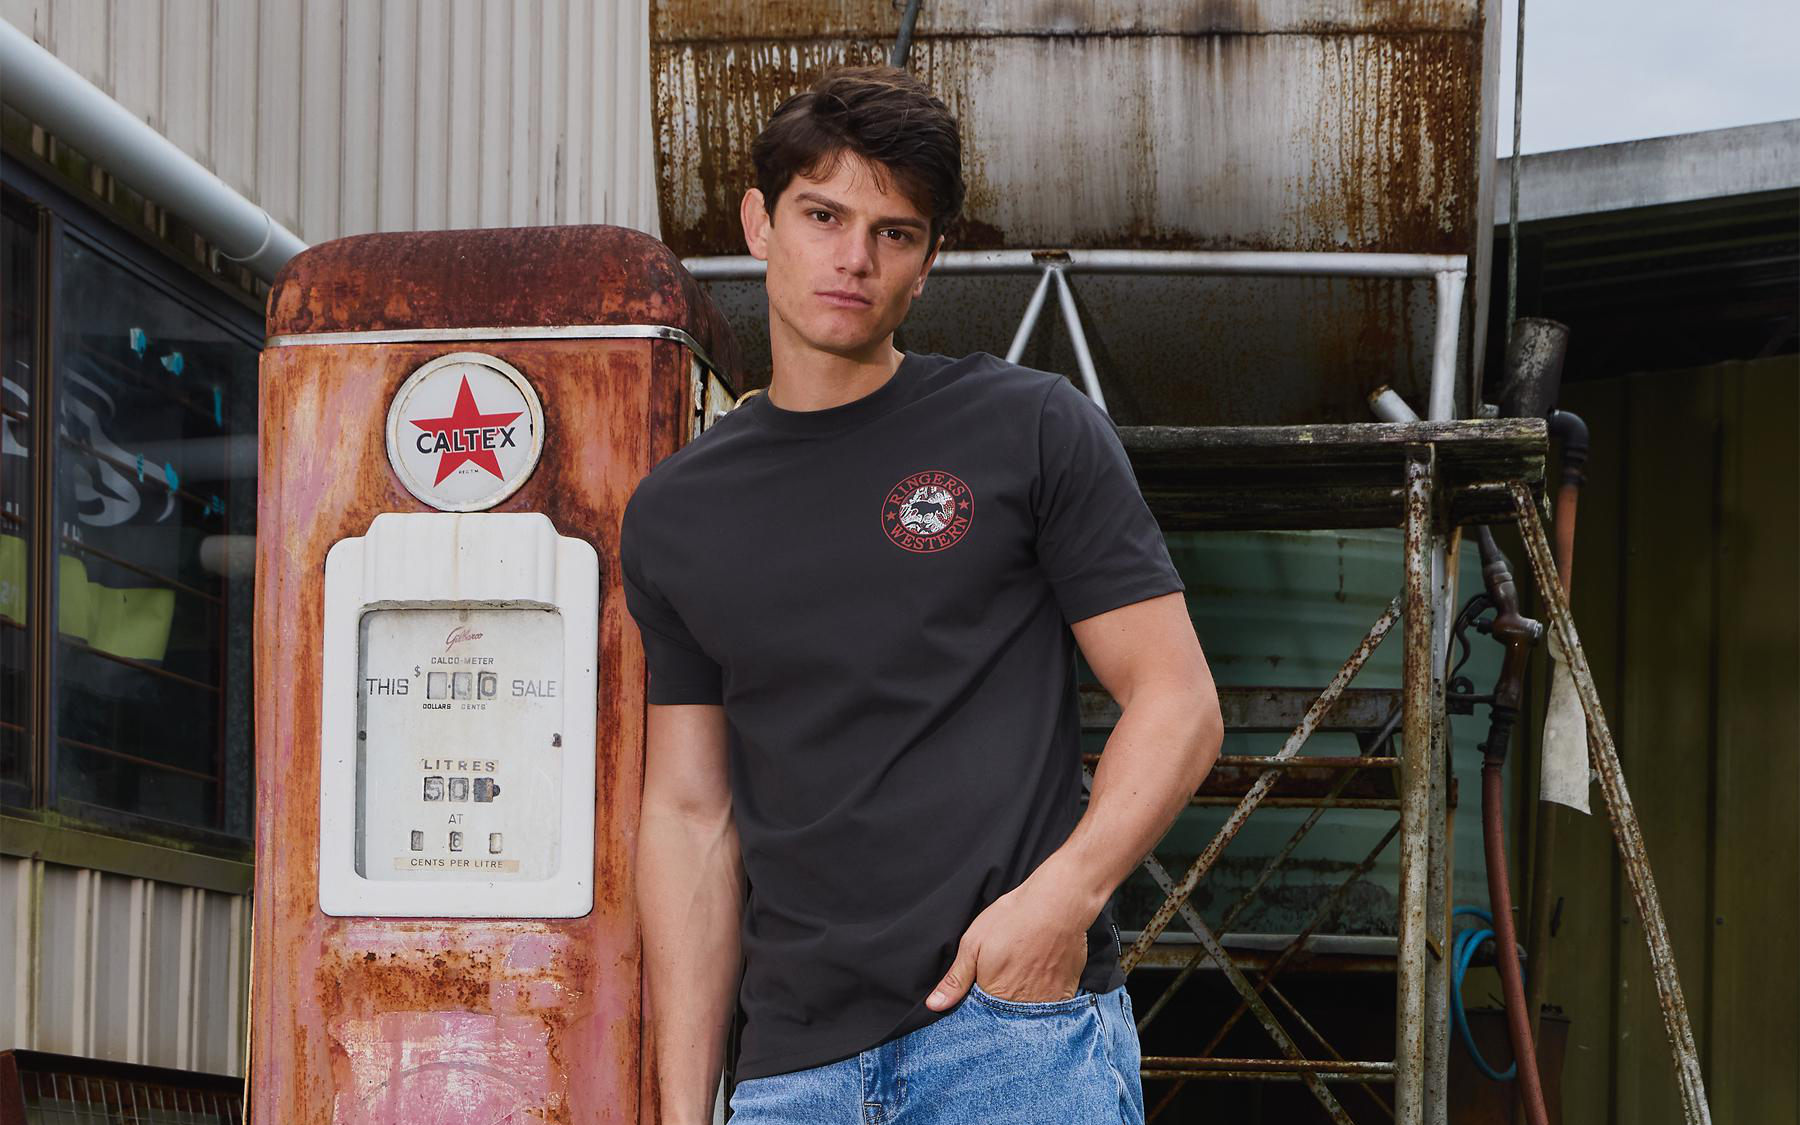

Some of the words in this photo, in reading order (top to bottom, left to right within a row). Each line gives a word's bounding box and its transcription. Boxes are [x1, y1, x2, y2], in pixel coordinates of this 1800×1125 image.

[416, 427, 516, 454] CALTEX
[889, 473, 966, 505] RINGERS
[891, 514, 968, 550] WESTERN
[431, 656, 494, 665] CALCO-METER
[366, 678, 409, 696] THIS
[512, 680, 557, 698] SALE
[423, 760, 496, 773] LITRES
[448, 813, 464, 825] AT
[410, 858, 445, 867] CENTS
[450, 859, 470, 868] PER
[474, 860, 504, 869] LITRE
